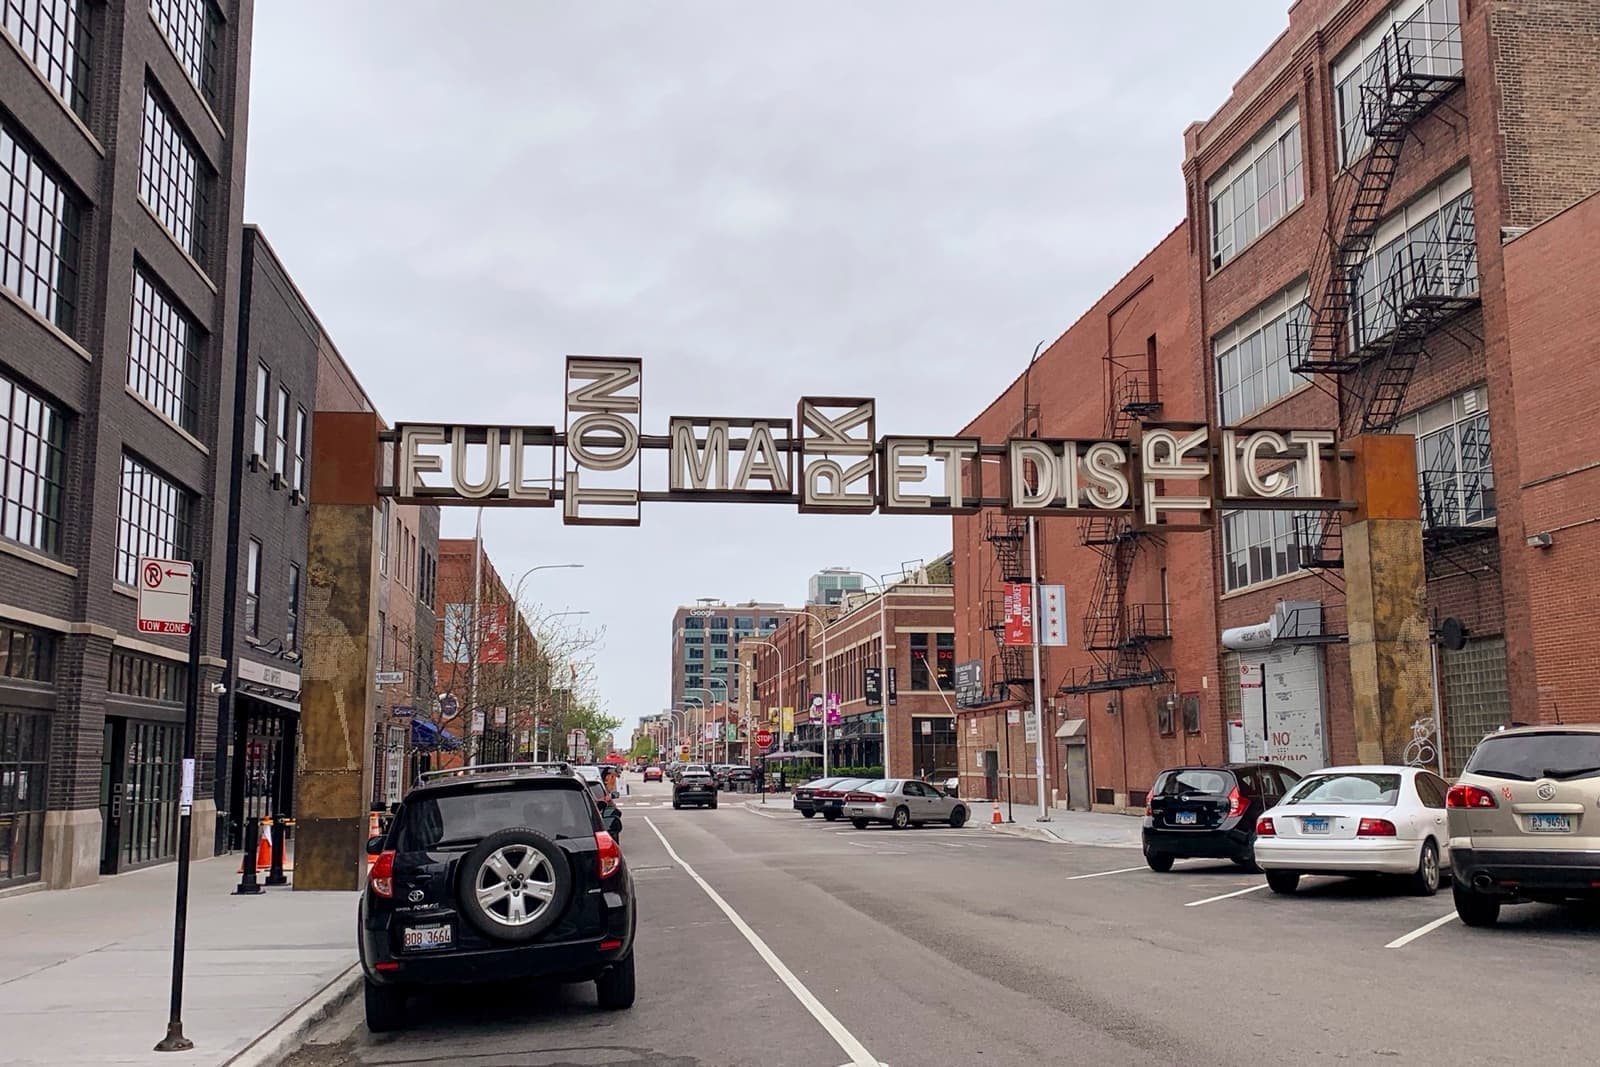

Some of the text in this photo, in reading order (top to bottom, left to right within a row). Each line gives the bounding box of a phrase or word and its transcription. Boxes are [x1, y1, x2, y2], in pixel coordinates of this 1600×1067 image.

[690, 608, 715, 618] Google
[142, 620, 187, 633] TOW ZONE
[757, 735, 772, 743] STOP
[1273, 732, 1290, 746] NO
[427, 930, 450, 943] 3664
